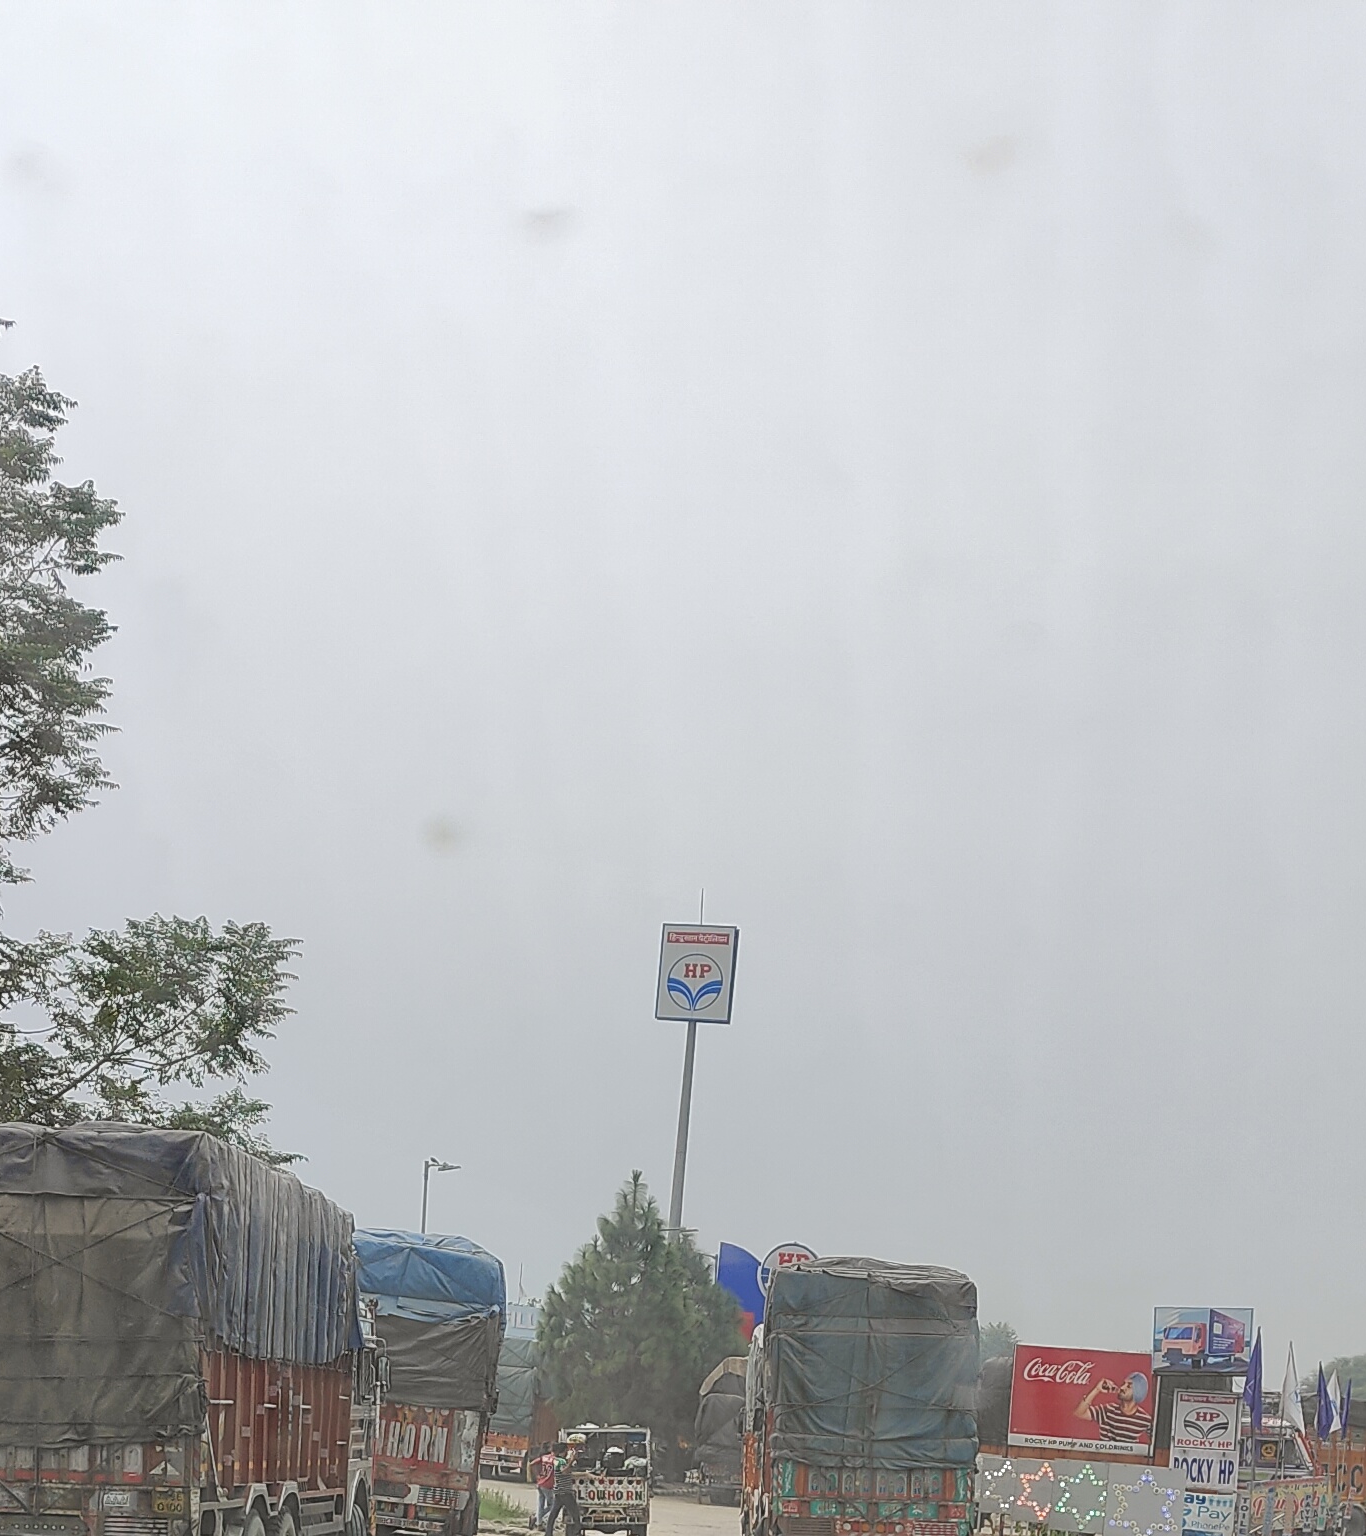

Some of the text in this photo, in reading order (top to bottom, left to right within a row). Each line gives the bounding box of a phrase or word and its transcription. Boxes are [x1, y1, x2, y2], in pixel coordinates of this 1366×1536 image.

[683, 963, 712, 978] HP
[1194, 1411, 1221, 1422] HP
[386, 1420, 448, 1464] HORN
[1176, 1438, 1233, 1449] ROCKY HP
[1218, 1459, 1235, 1485] HP
[572, 1489, 606, 1502] LOW
[1197, 1505, 1232, 1522] Pay
